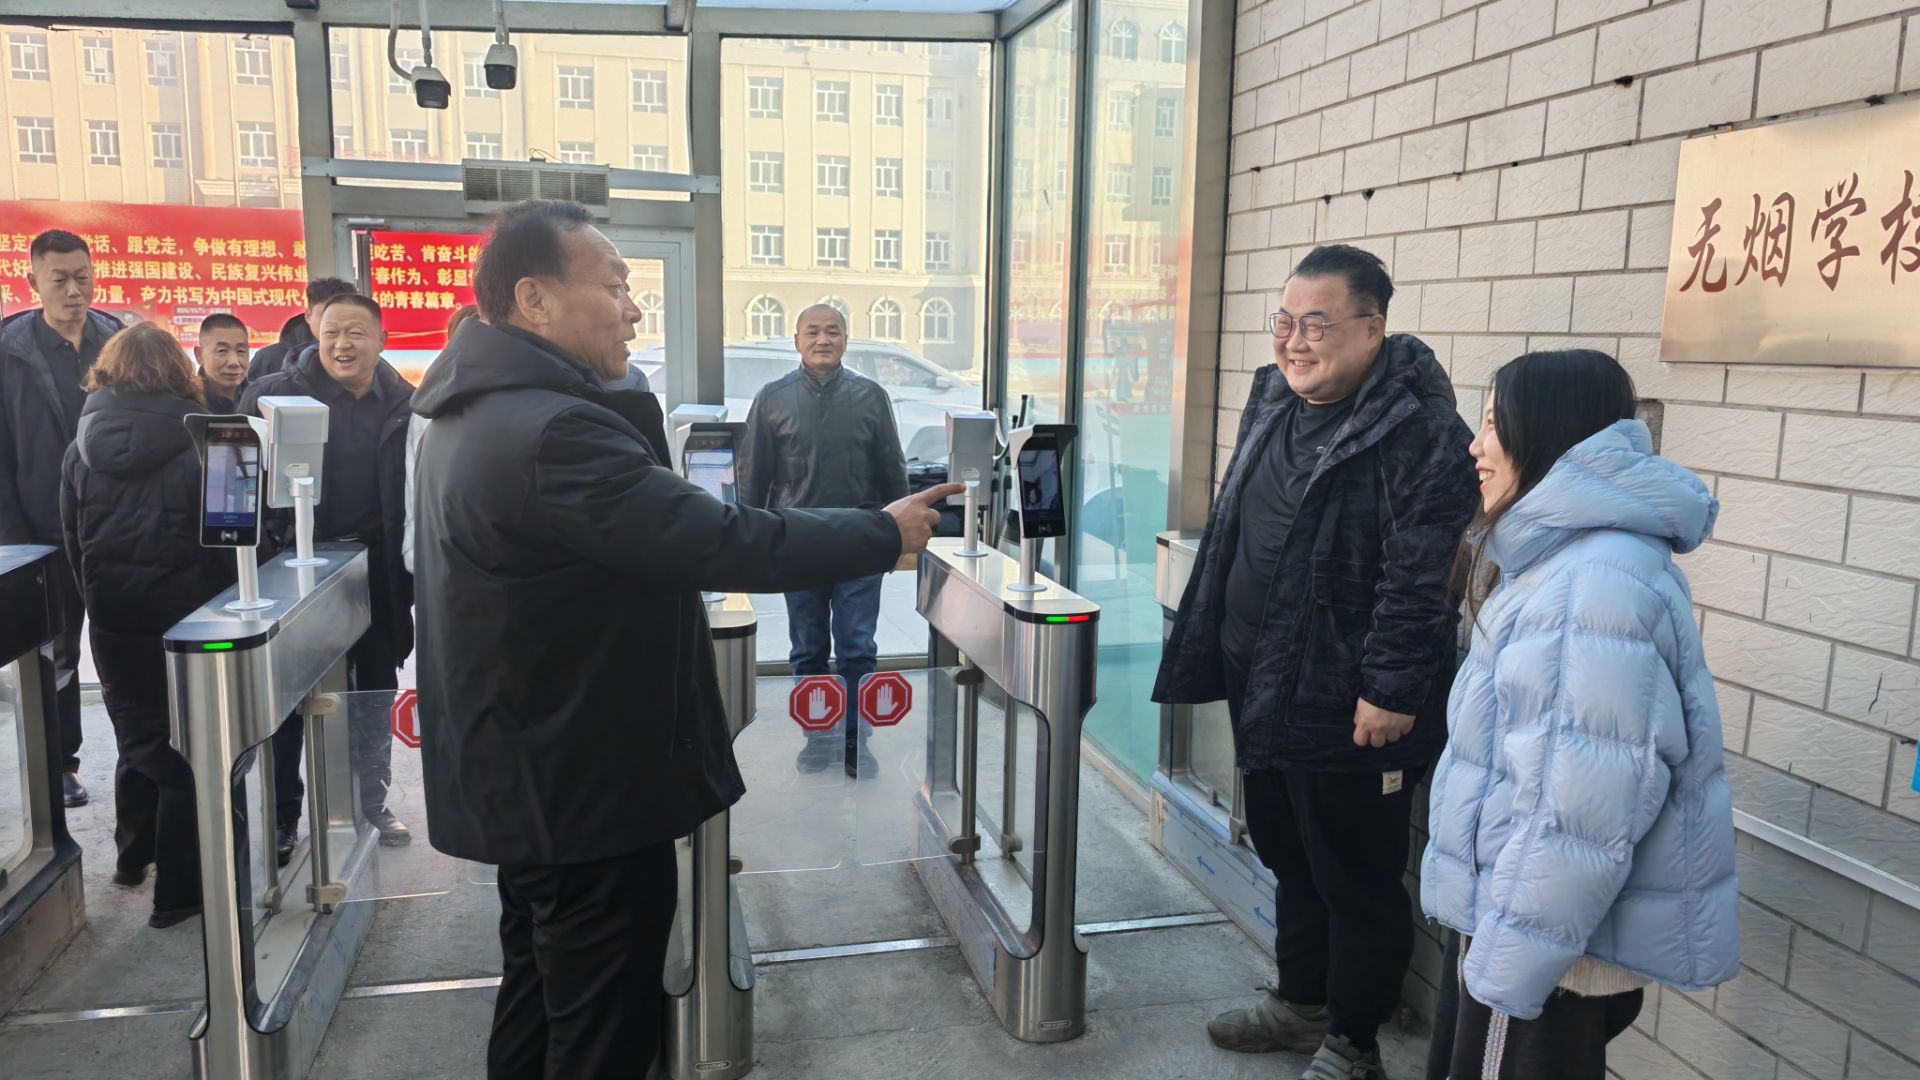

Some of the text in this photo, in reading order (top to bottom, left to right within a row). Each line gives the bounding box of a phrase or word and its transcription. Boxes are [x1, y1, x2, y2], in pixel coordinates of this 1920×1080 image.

[1679, 169, 1920, 293] 无烟学校
[370, 244, 479, 263] 吃苦、肯奋斗的
[371, 266, 475, 286] 春作为、彰显
